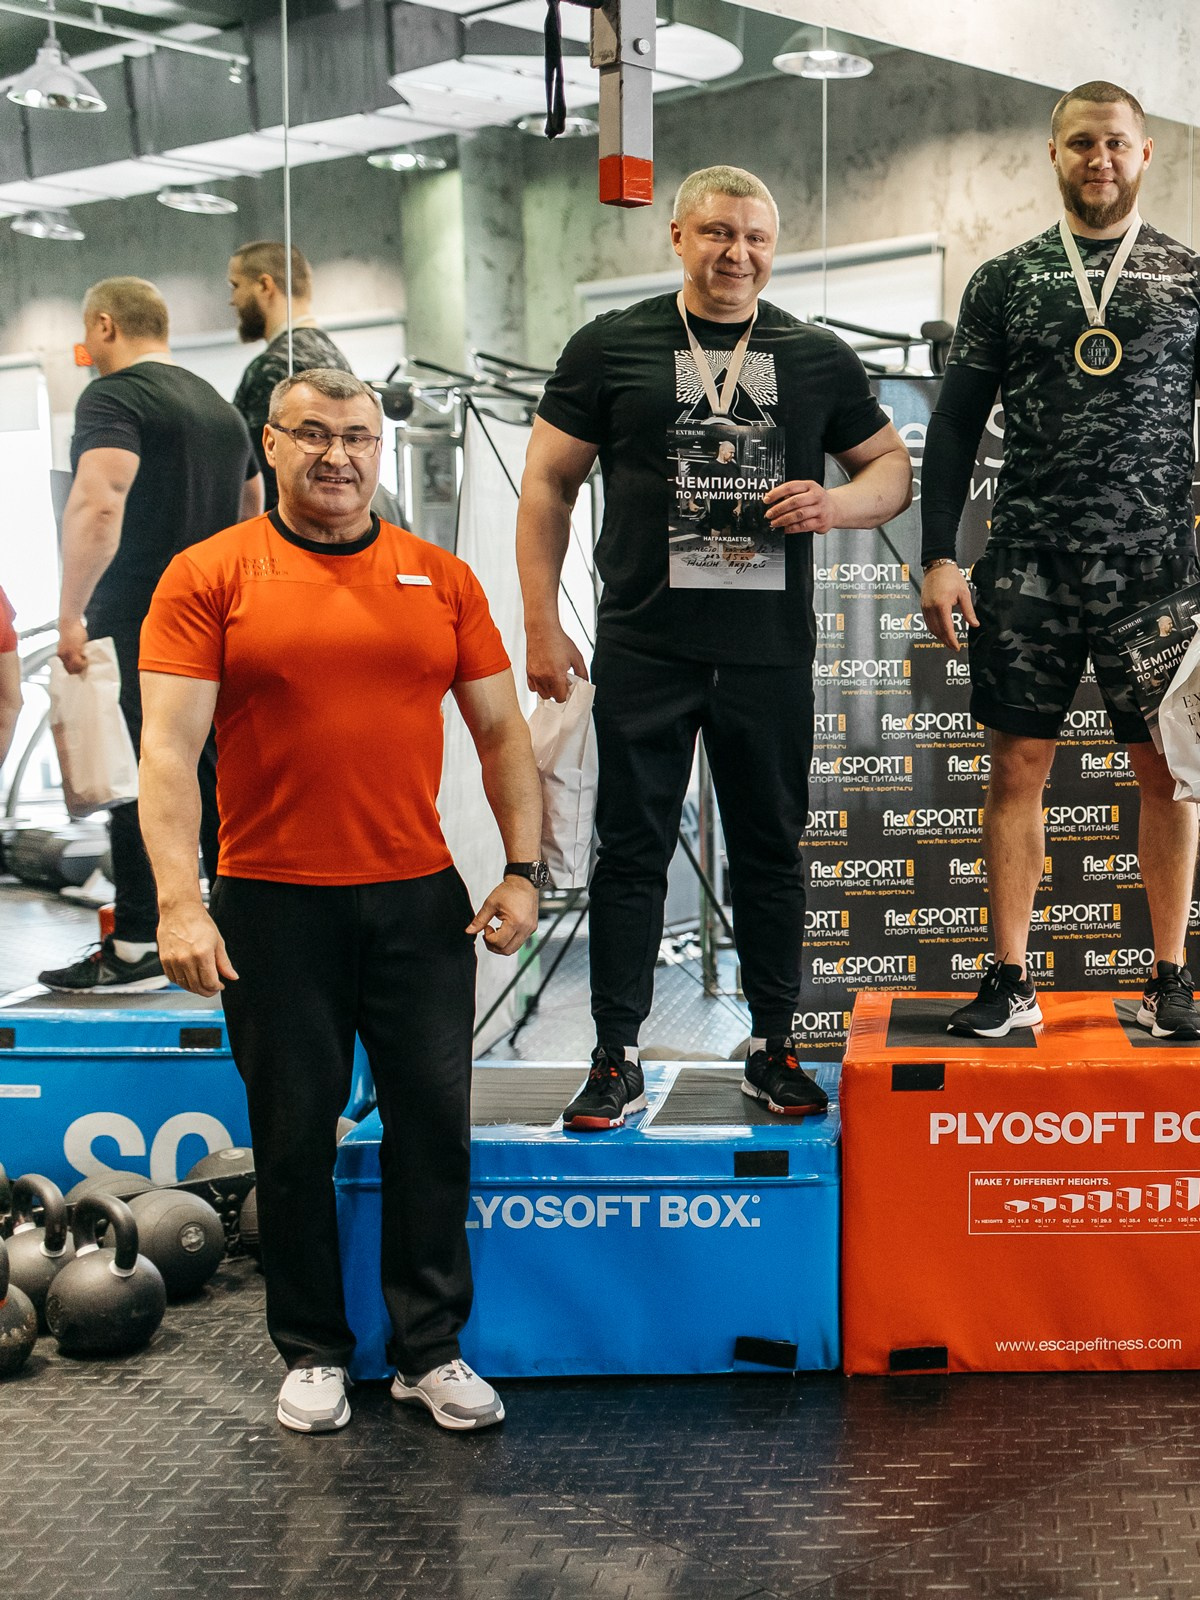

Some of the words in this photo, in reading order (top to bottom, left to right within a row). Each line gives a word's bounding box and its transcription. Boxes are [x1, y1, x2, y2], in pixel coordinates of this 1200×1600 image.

[1053, 269, 1105, 280] UNER
[1118, 271, 1172, 283] RMOUR
[675, 476, 778, 490] ЧЕМПИОНАТ
[676, 490, 692, 499] ПО
[694, 491, 767, 501] АРМЛИФТИН
[703, 535, 752, 543] НАГРАЖДАЕТСЯ
[814, 582, 867, 591] ПОРТИВНОЕ
[868, 582, 910, 591] ПИТАНИЕ
[1117, 616, 1143, 633] EXTREME
[869, 678, 911, 686] ПИТАНИЕ
[1136, 671, 1151, 683] ПО
[881, 732, 941, 741] СПОРТИВНОЕ
[943, 731, 985, 740] ПИТАНИЕ
[809, 775, 869, 783] СПОРТИВНОЕ
[871, 774, 913, 783] ПИТАНИЕ
[806, 829, 848, 837] ПИТАНИЕ
[883, 828, 943, 837] СПОРТИВНОЕ
[1078, 824, 1119, 832] ПИТАНИЕ
[810, 879, 871, 888] СПОРТИВНОЕ
[873, 878, 915, 887] ПИТАНИЕ
[884, 927, 944, 936] СПОРТИВНОЕ
[946, 926, 988, 934] ПИТАНИЕ
[1079, 922, 1121, 930] ПИТАНИЕ
[808, 929, 849, 937] ПИТАНИЕ
[1084, 967, 1144, 976] СПОРТИВНОЕ
[811, 976, 872, 984] СПОРТИВНОЕ
[874, 974, 916, 982] ПИТАНИЕ
[929, 1110, 1145, 1145] PLYOSOFT
[974, 1178, 1003, 1186] MAKE
[1005, 1178, 1011, 1186] 7
[1013, 1178, 1066, 1186] DIFFERENT
[1067, 1177, 1112, 1186] HEIGHTS.
[465, 1194, 650, 1230] YOSOFT
[995, 1336, 1182, 1354] www.escapefitness.com
